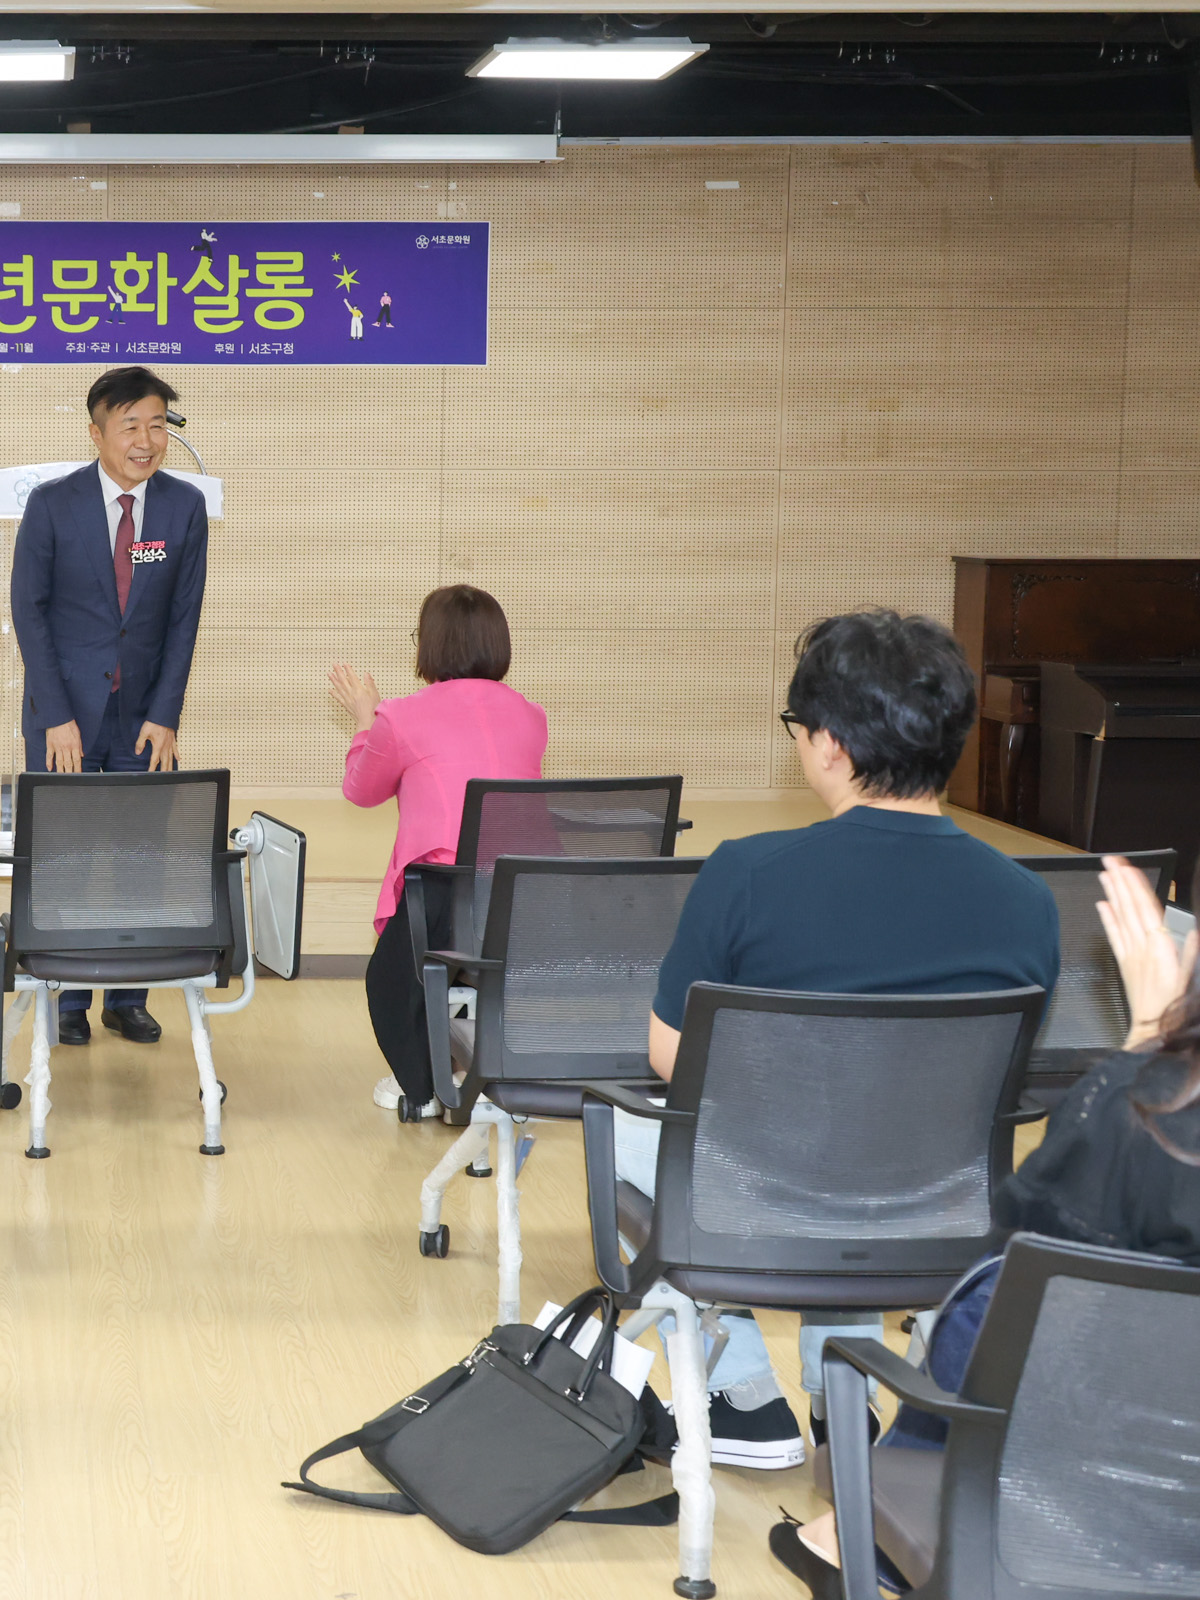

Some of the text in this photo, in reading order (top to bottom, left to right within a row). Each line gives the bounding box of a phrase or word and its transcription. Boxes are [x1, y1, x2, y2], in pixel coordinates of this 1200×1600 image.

[431, 235, 471, 245] 서초문화원
[125, 342, 182, 354] 서초문화원
[214, 343, 294, 355] 후원 서초구청
[132, 541, 166, 550] 서초구청장
[131, 548, 167, 564] 전성수
